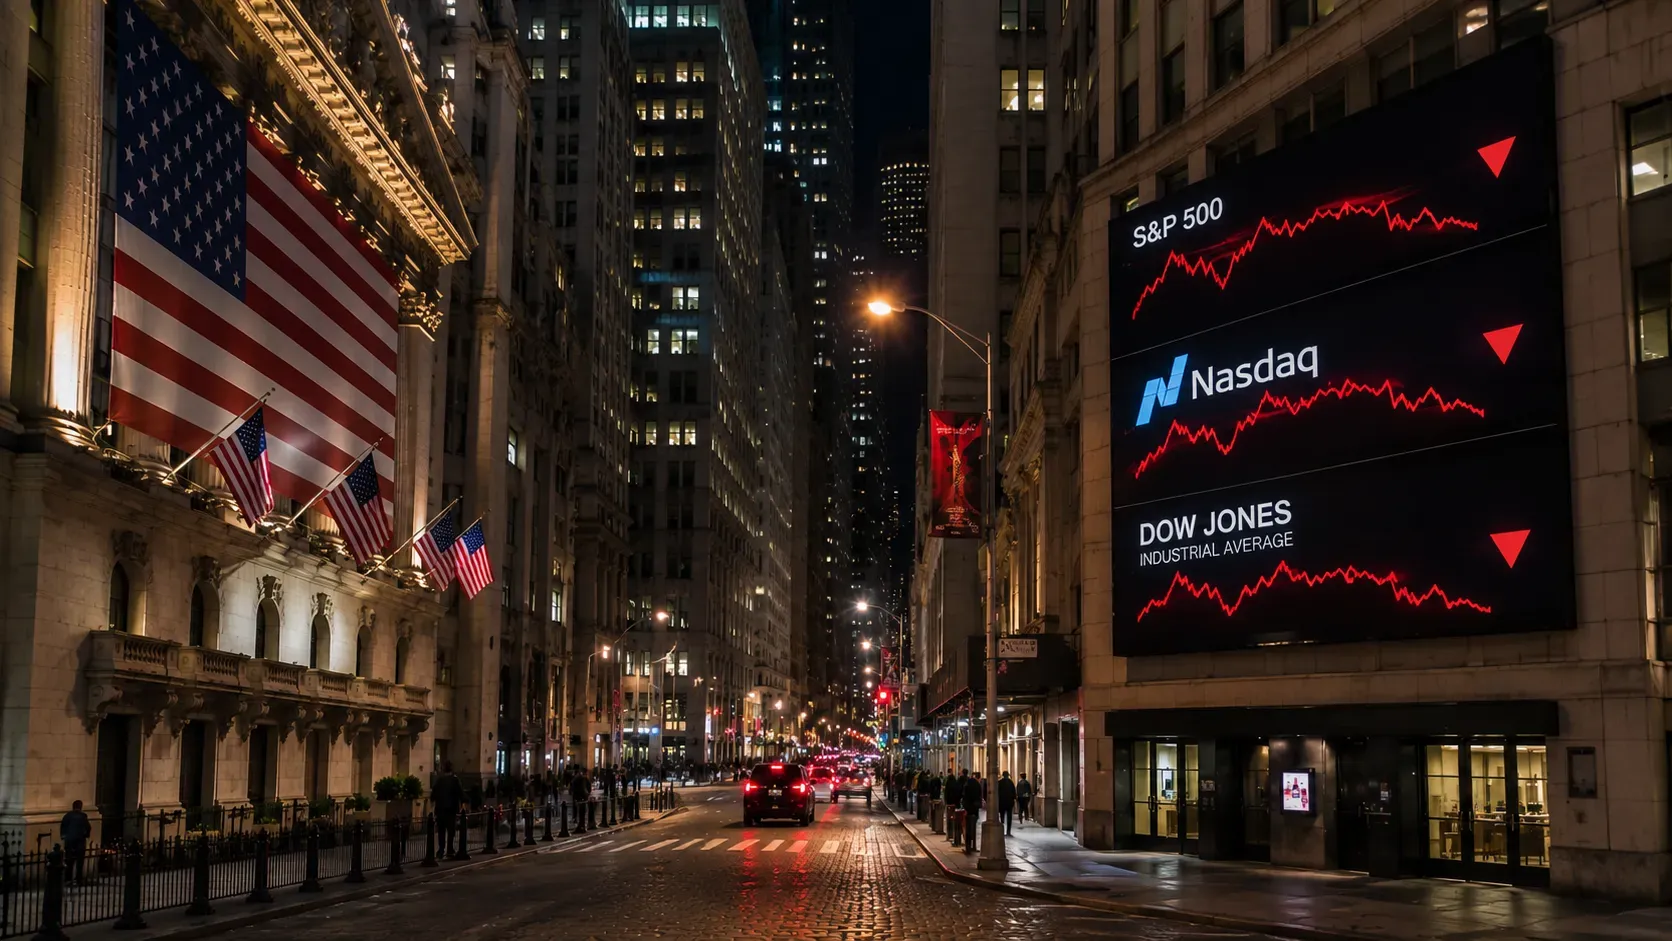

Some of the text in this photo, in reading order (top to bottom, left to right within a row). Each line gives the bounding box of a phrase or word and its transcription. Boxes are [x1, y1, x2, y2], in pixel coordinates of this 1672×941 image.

[1132, 196, 1223, 248] S&P 500
[1191, 345, 1319, 400] Nasdaq
[1139, 499, 1292, 547] DOW JONES
[1139, 530, 1294, 567] INDUSTRIAL AVERAGE
